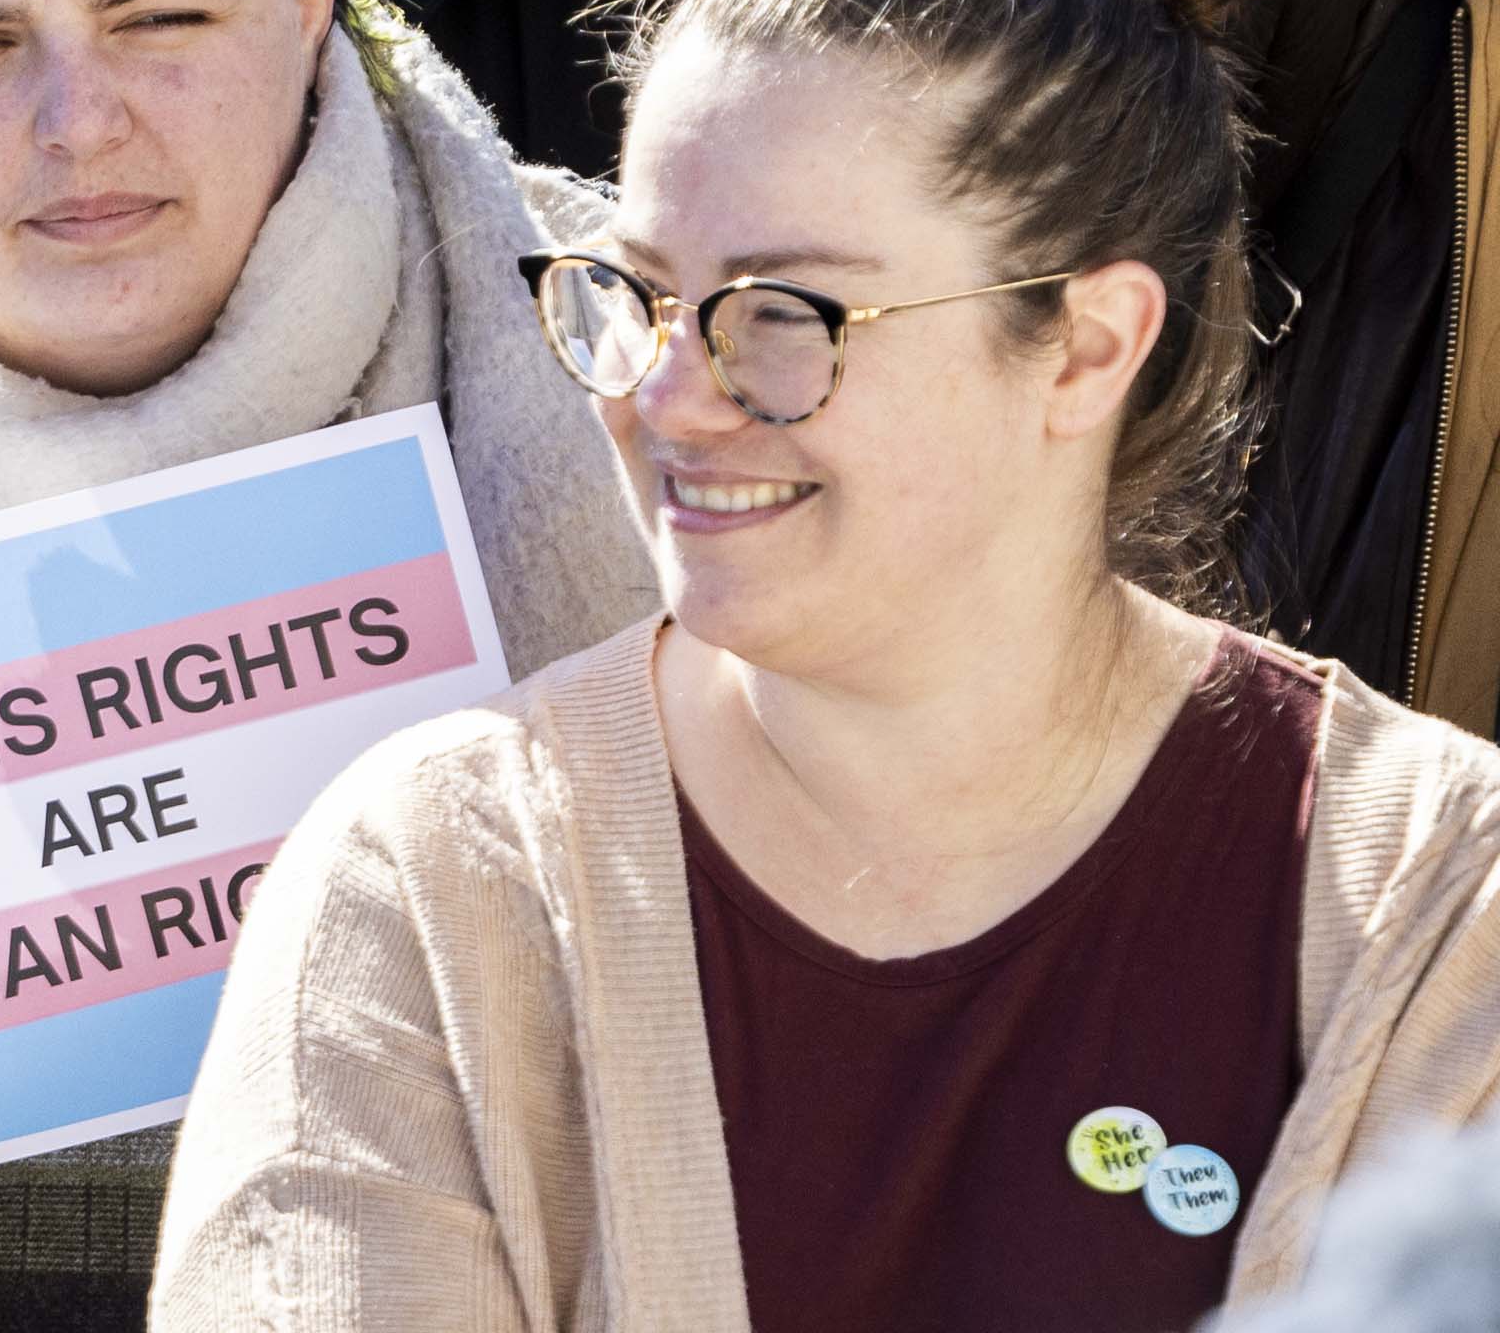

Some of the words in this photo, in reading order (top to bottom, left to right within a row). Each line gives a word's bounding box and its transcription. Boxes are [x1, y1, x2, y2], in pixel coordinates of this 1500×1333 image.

[77, 597, 411, 739] RIGHTS
[40, 767, 198, 868] ARE
[1094, 1124, 1143, 1151] She
[1101, 1145, 1152, 1174] Her
[1164, 1163, 1218, 1187] They
[1169, 1188, 1228, 1211] Them
